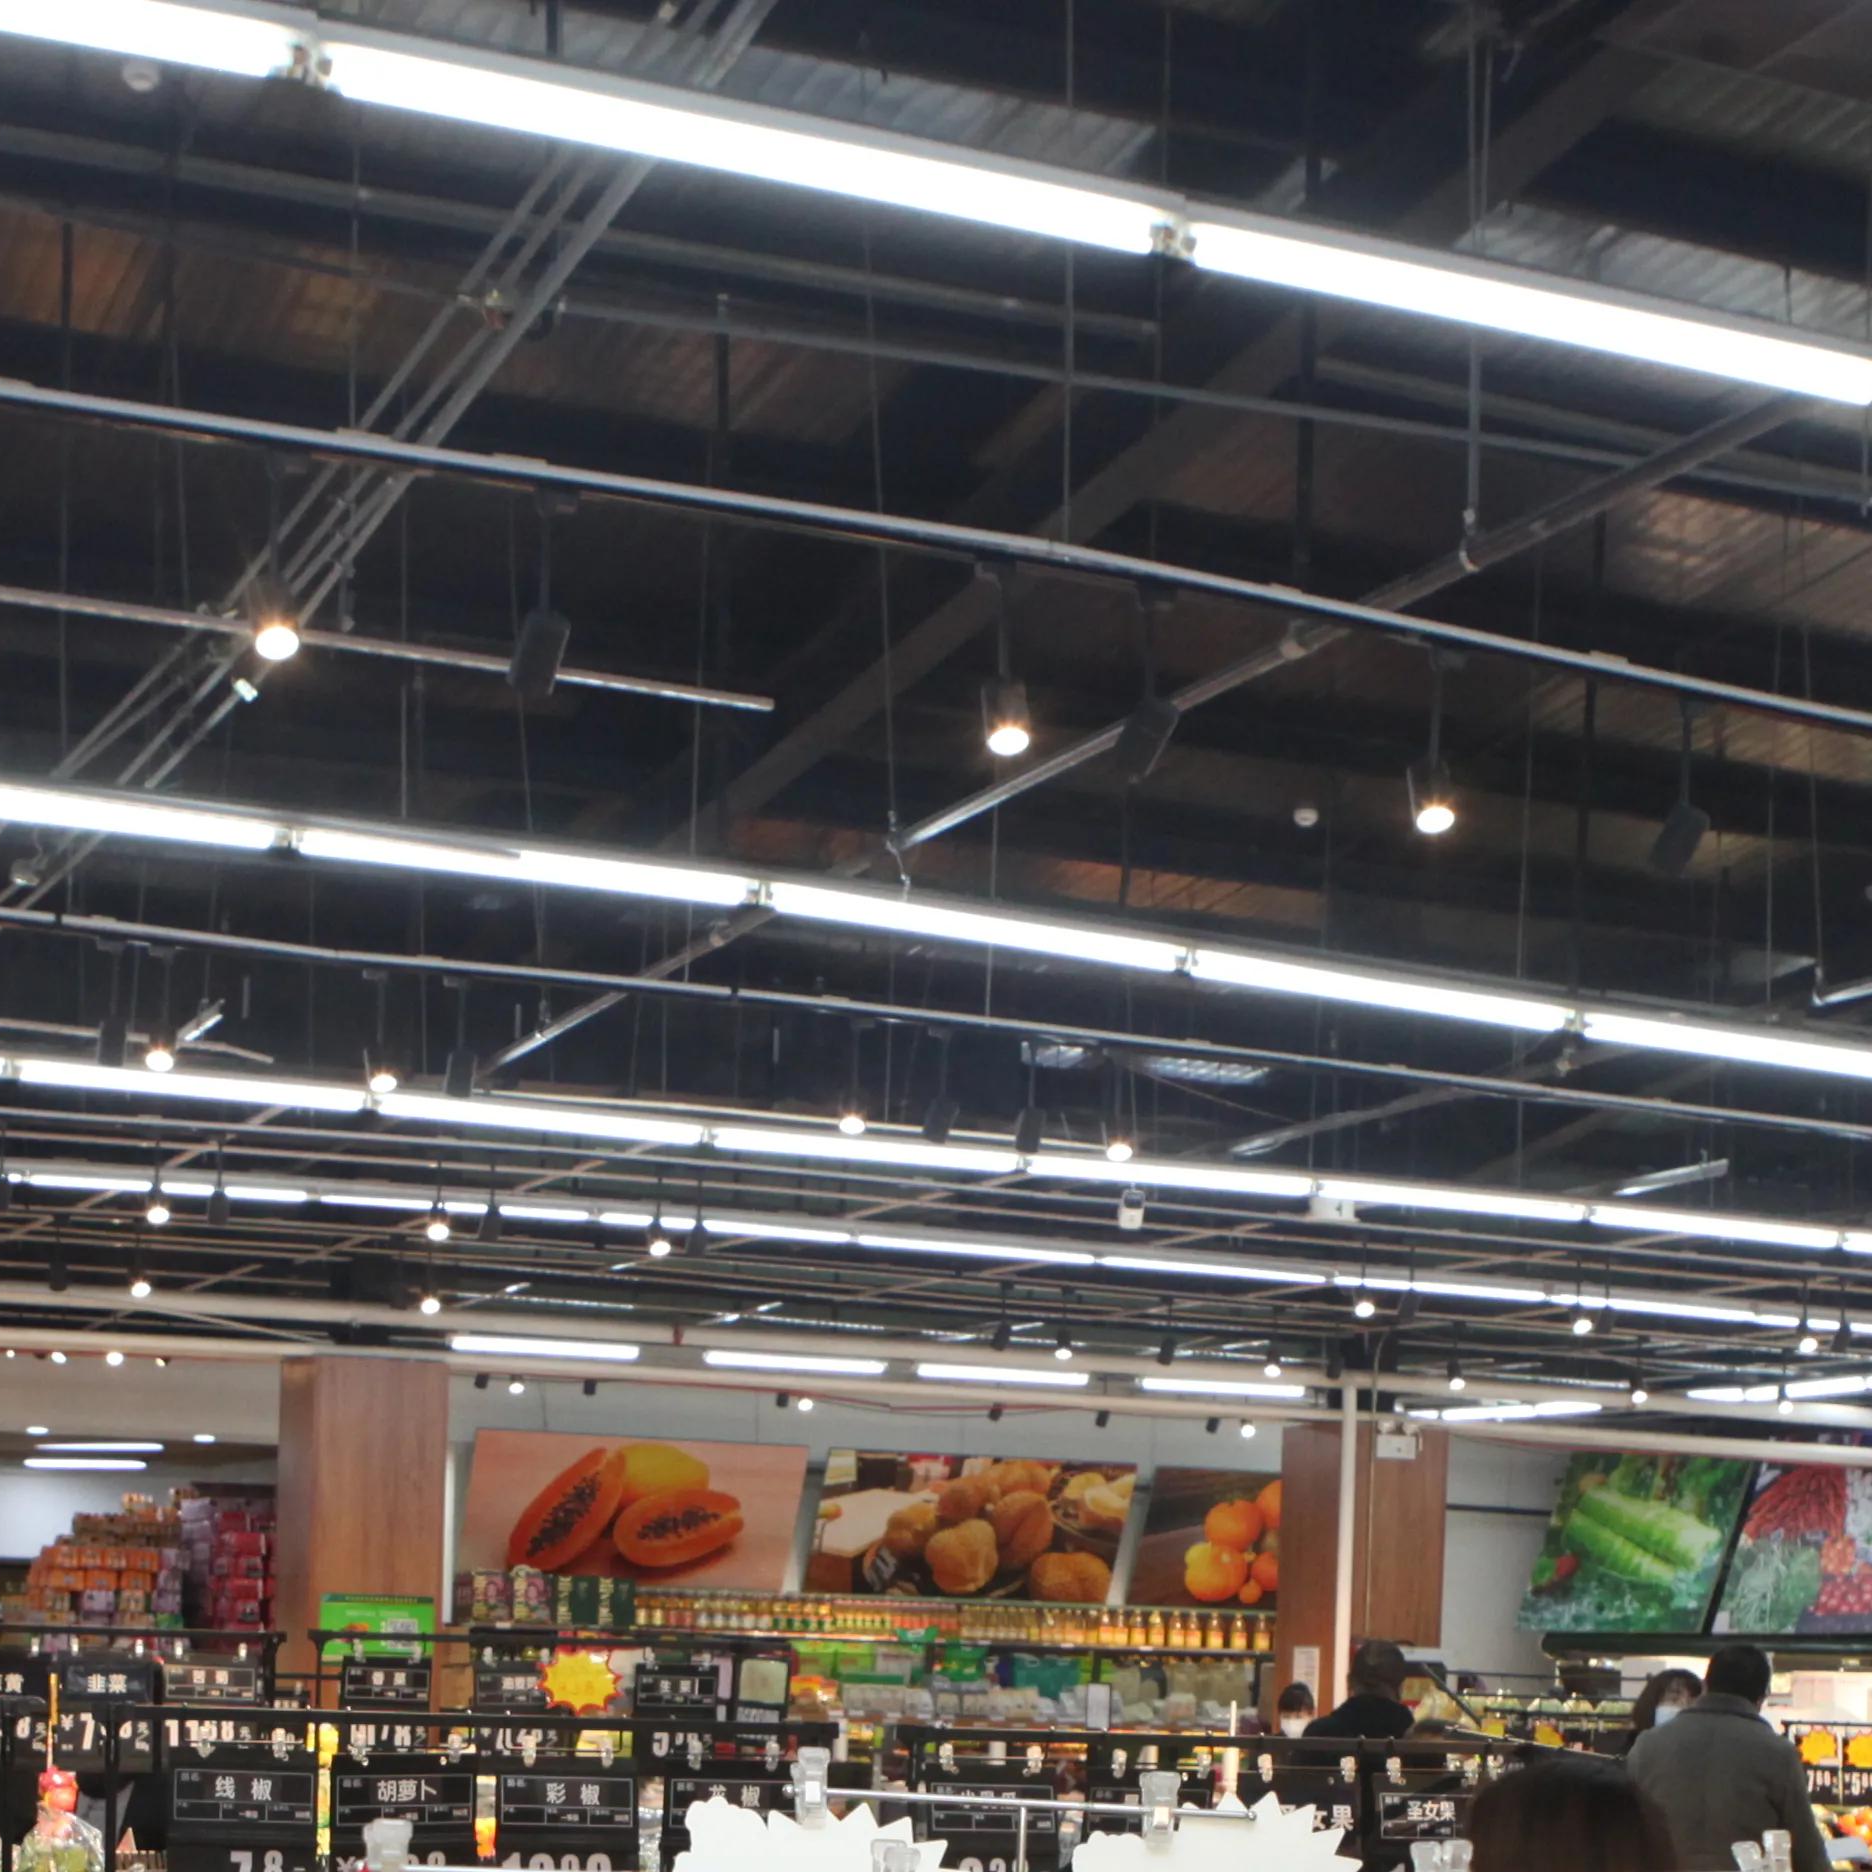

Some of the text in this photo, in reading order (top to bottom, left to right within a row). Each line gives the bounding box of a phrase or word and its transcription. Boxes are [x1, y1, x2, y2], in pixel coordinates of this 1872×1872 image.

[214, 1776, 273, 1802] 线椒
[376, 1780, 438, 1802] 胡萝卜
[545, 1782, 602, 1806] 彩椒
[1406, 1801, 1457, 1822] 圣女果
